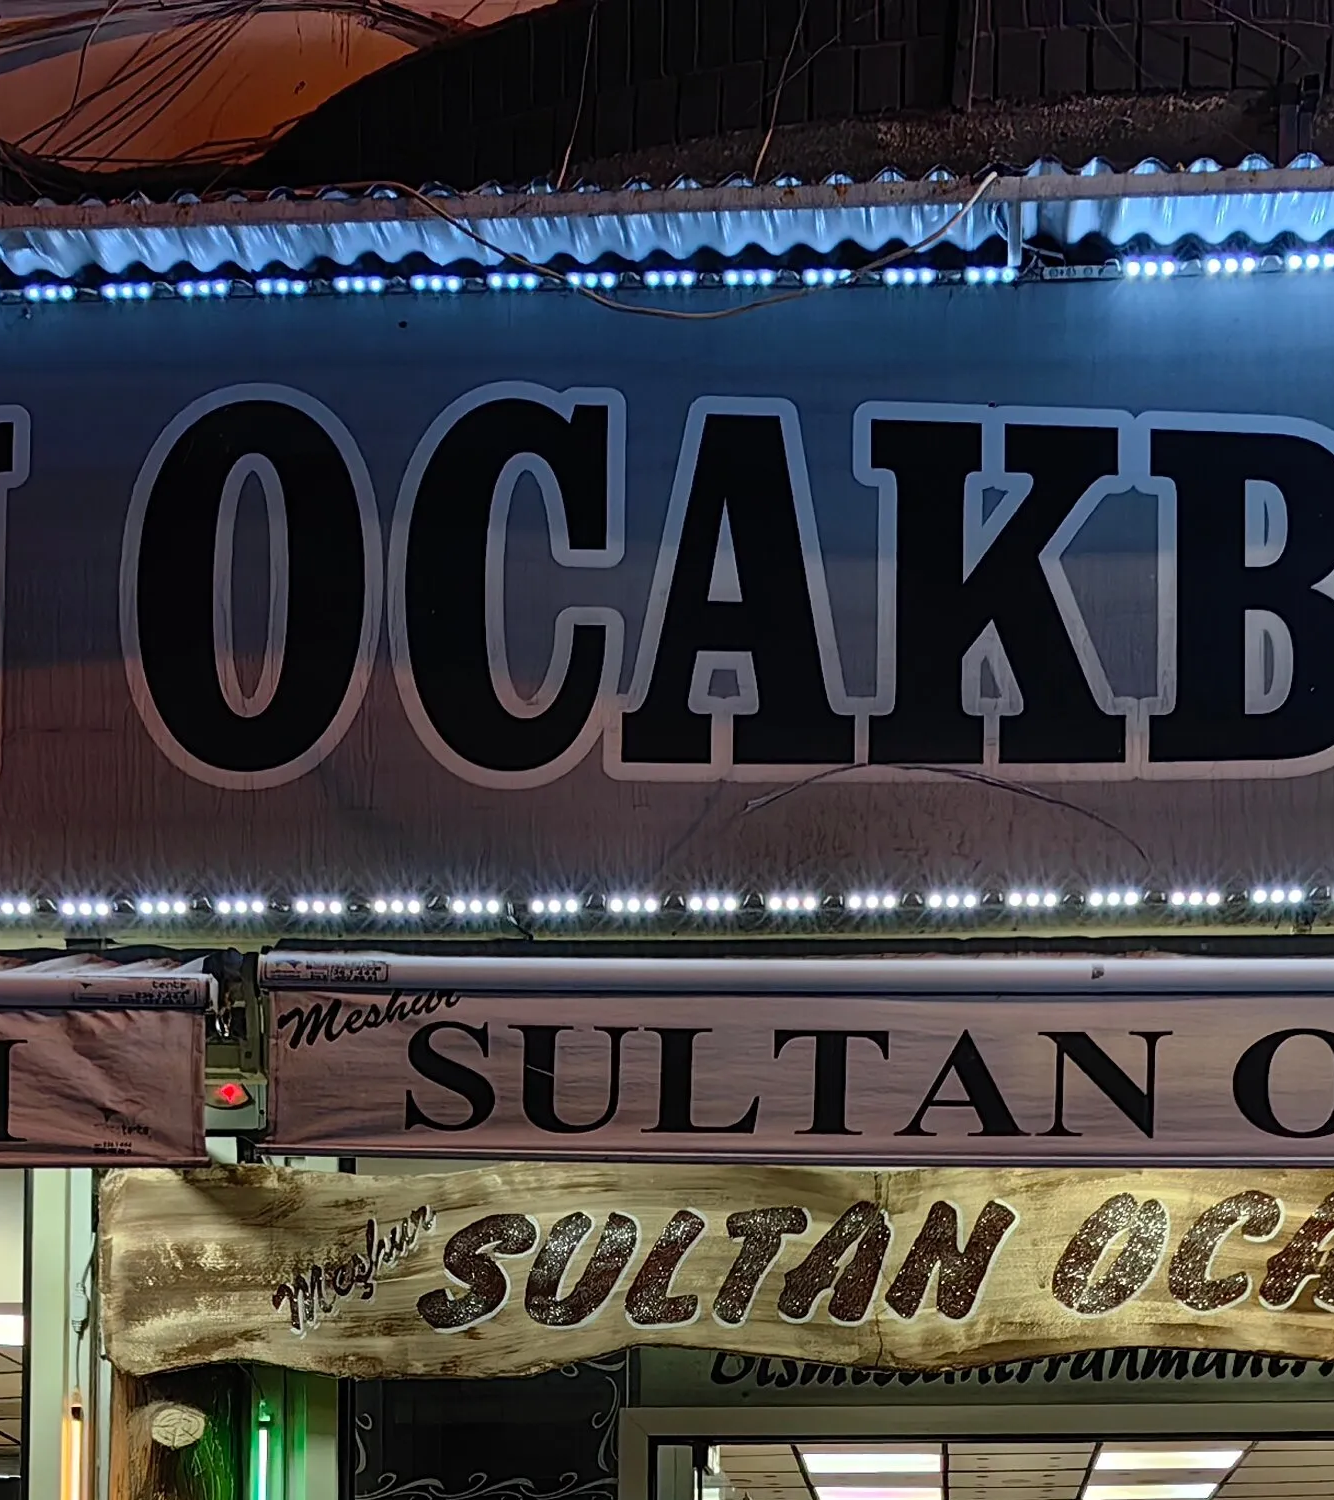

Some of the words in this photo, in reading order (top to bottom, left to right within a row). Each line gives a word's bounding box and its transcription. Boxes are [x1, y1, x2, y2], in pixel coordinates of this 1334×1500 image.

[404, 1020, 1172, 1139] SULTAN
[272, 1204, 437, 1338] Meşhur
[415, 1200, 1019, 1332] SULTAN
